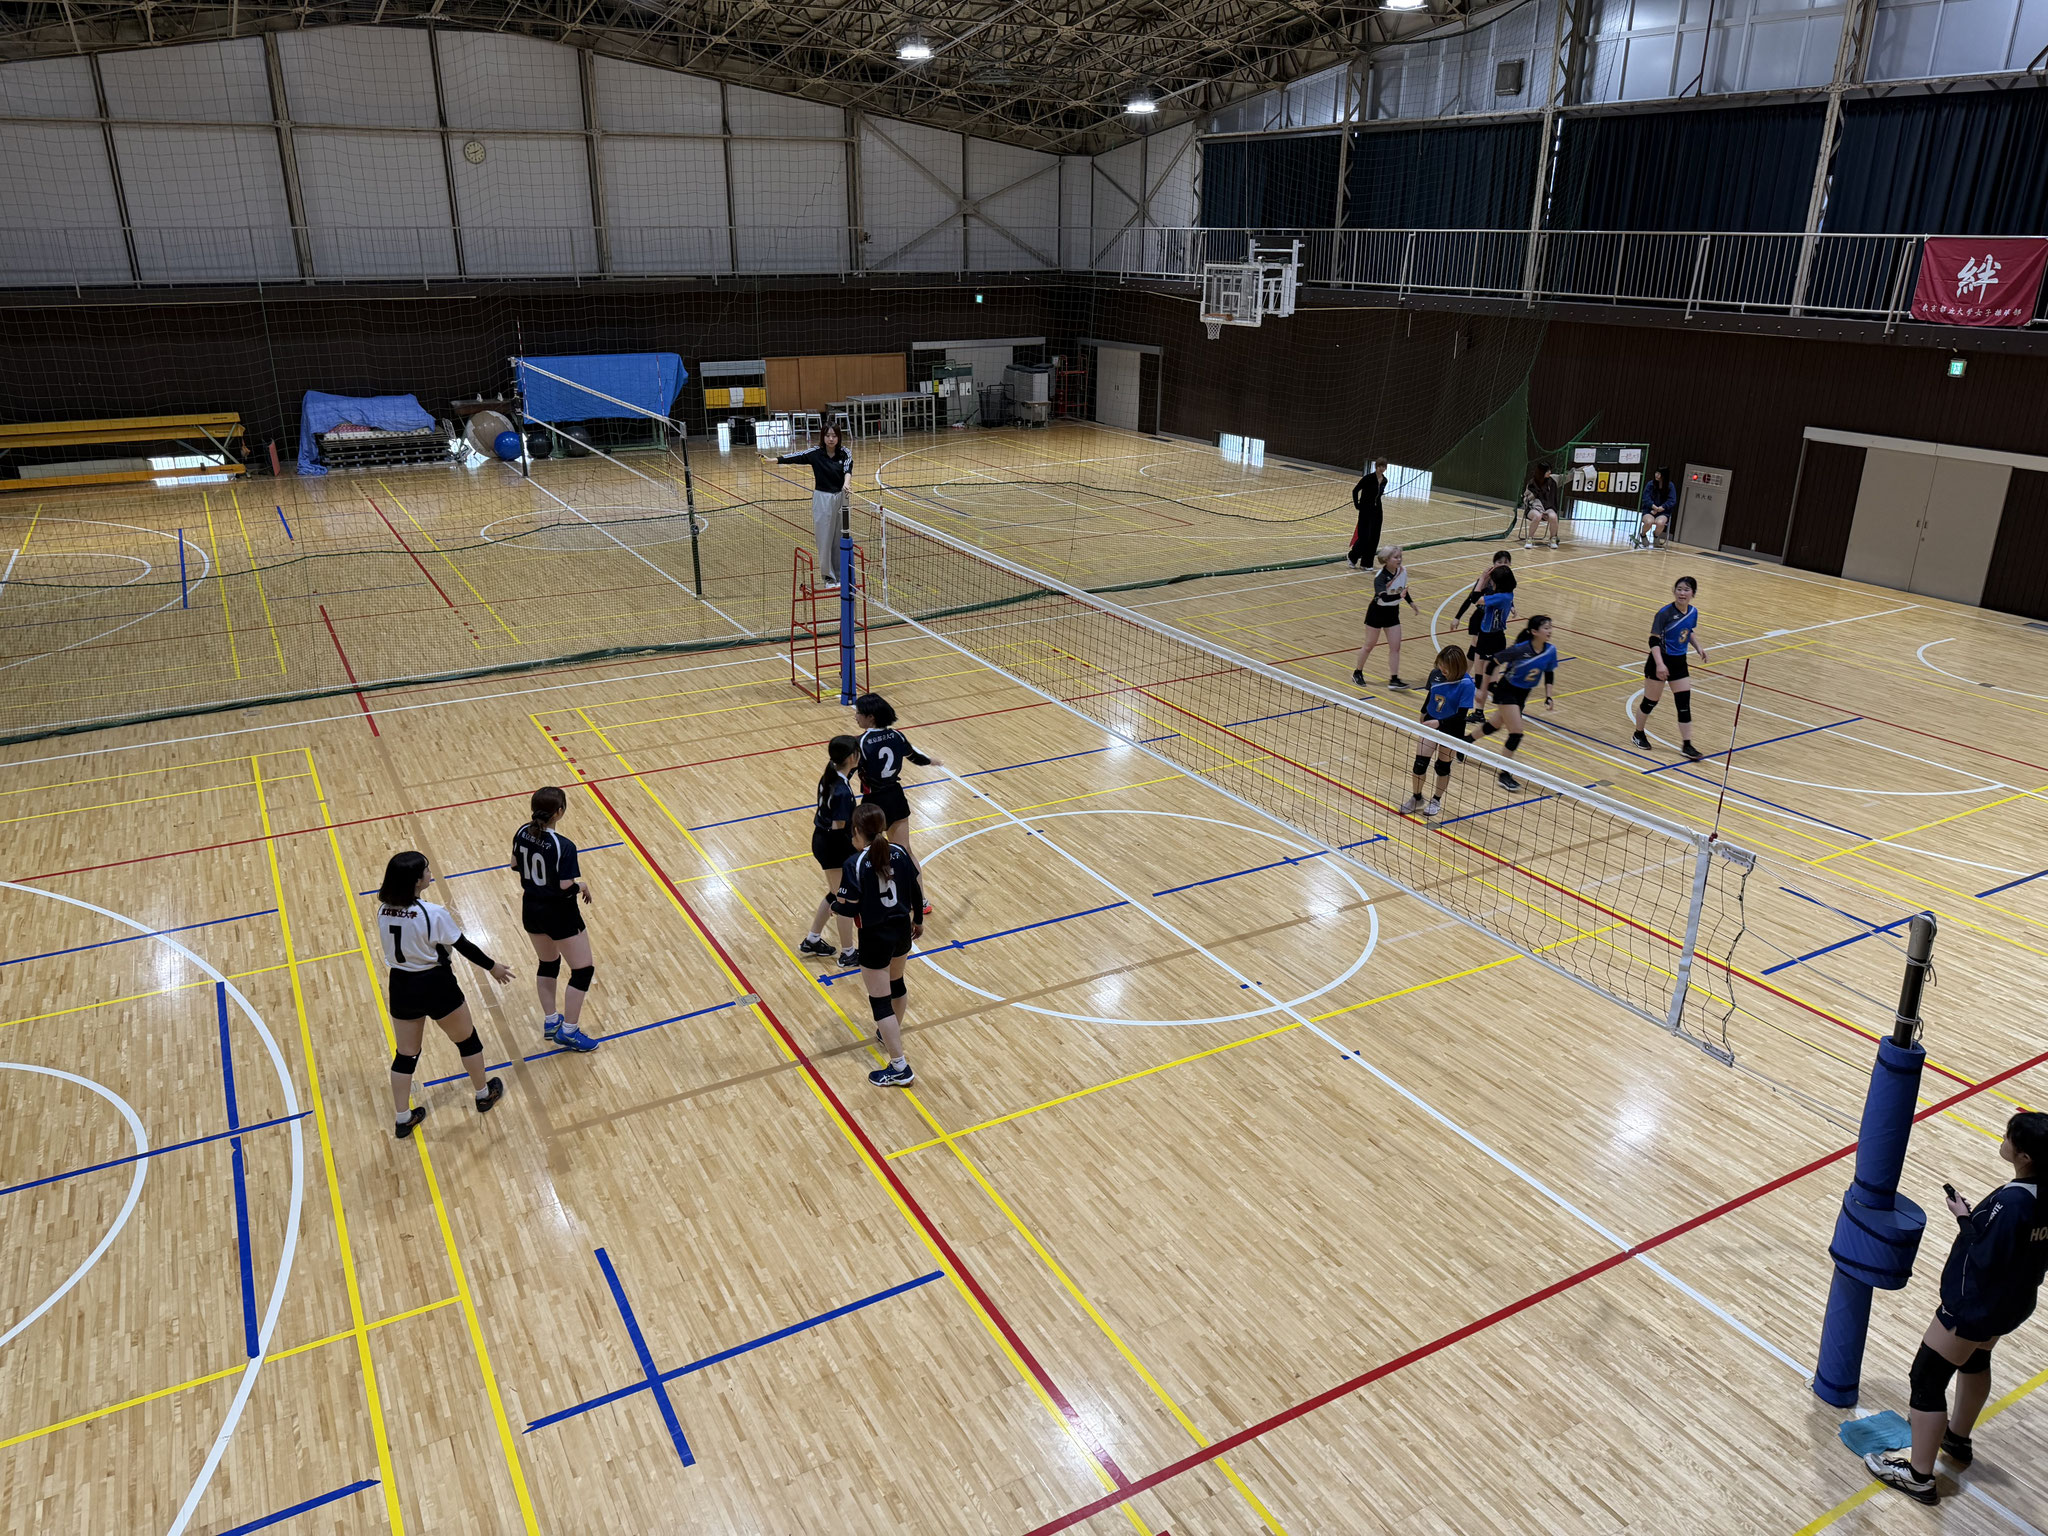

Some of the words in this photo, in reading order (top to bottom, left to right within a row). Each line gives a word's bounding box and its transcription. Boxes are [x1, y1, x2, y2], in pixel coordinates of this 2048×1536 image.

[1956, 253, 2002, 304] 絆
[1679, 628, 1690, 644] 3
[1525, 668, 1540, 682] 2
[1434, 694, 1446, 713] 7
[878, 746, 897, 778] 2
[519, 846, 547, 887] 10
[876, 867, 898, 908] 5
[389, 925, 407, 964] 1
[2030, 1226, 2048, 1242] HO
